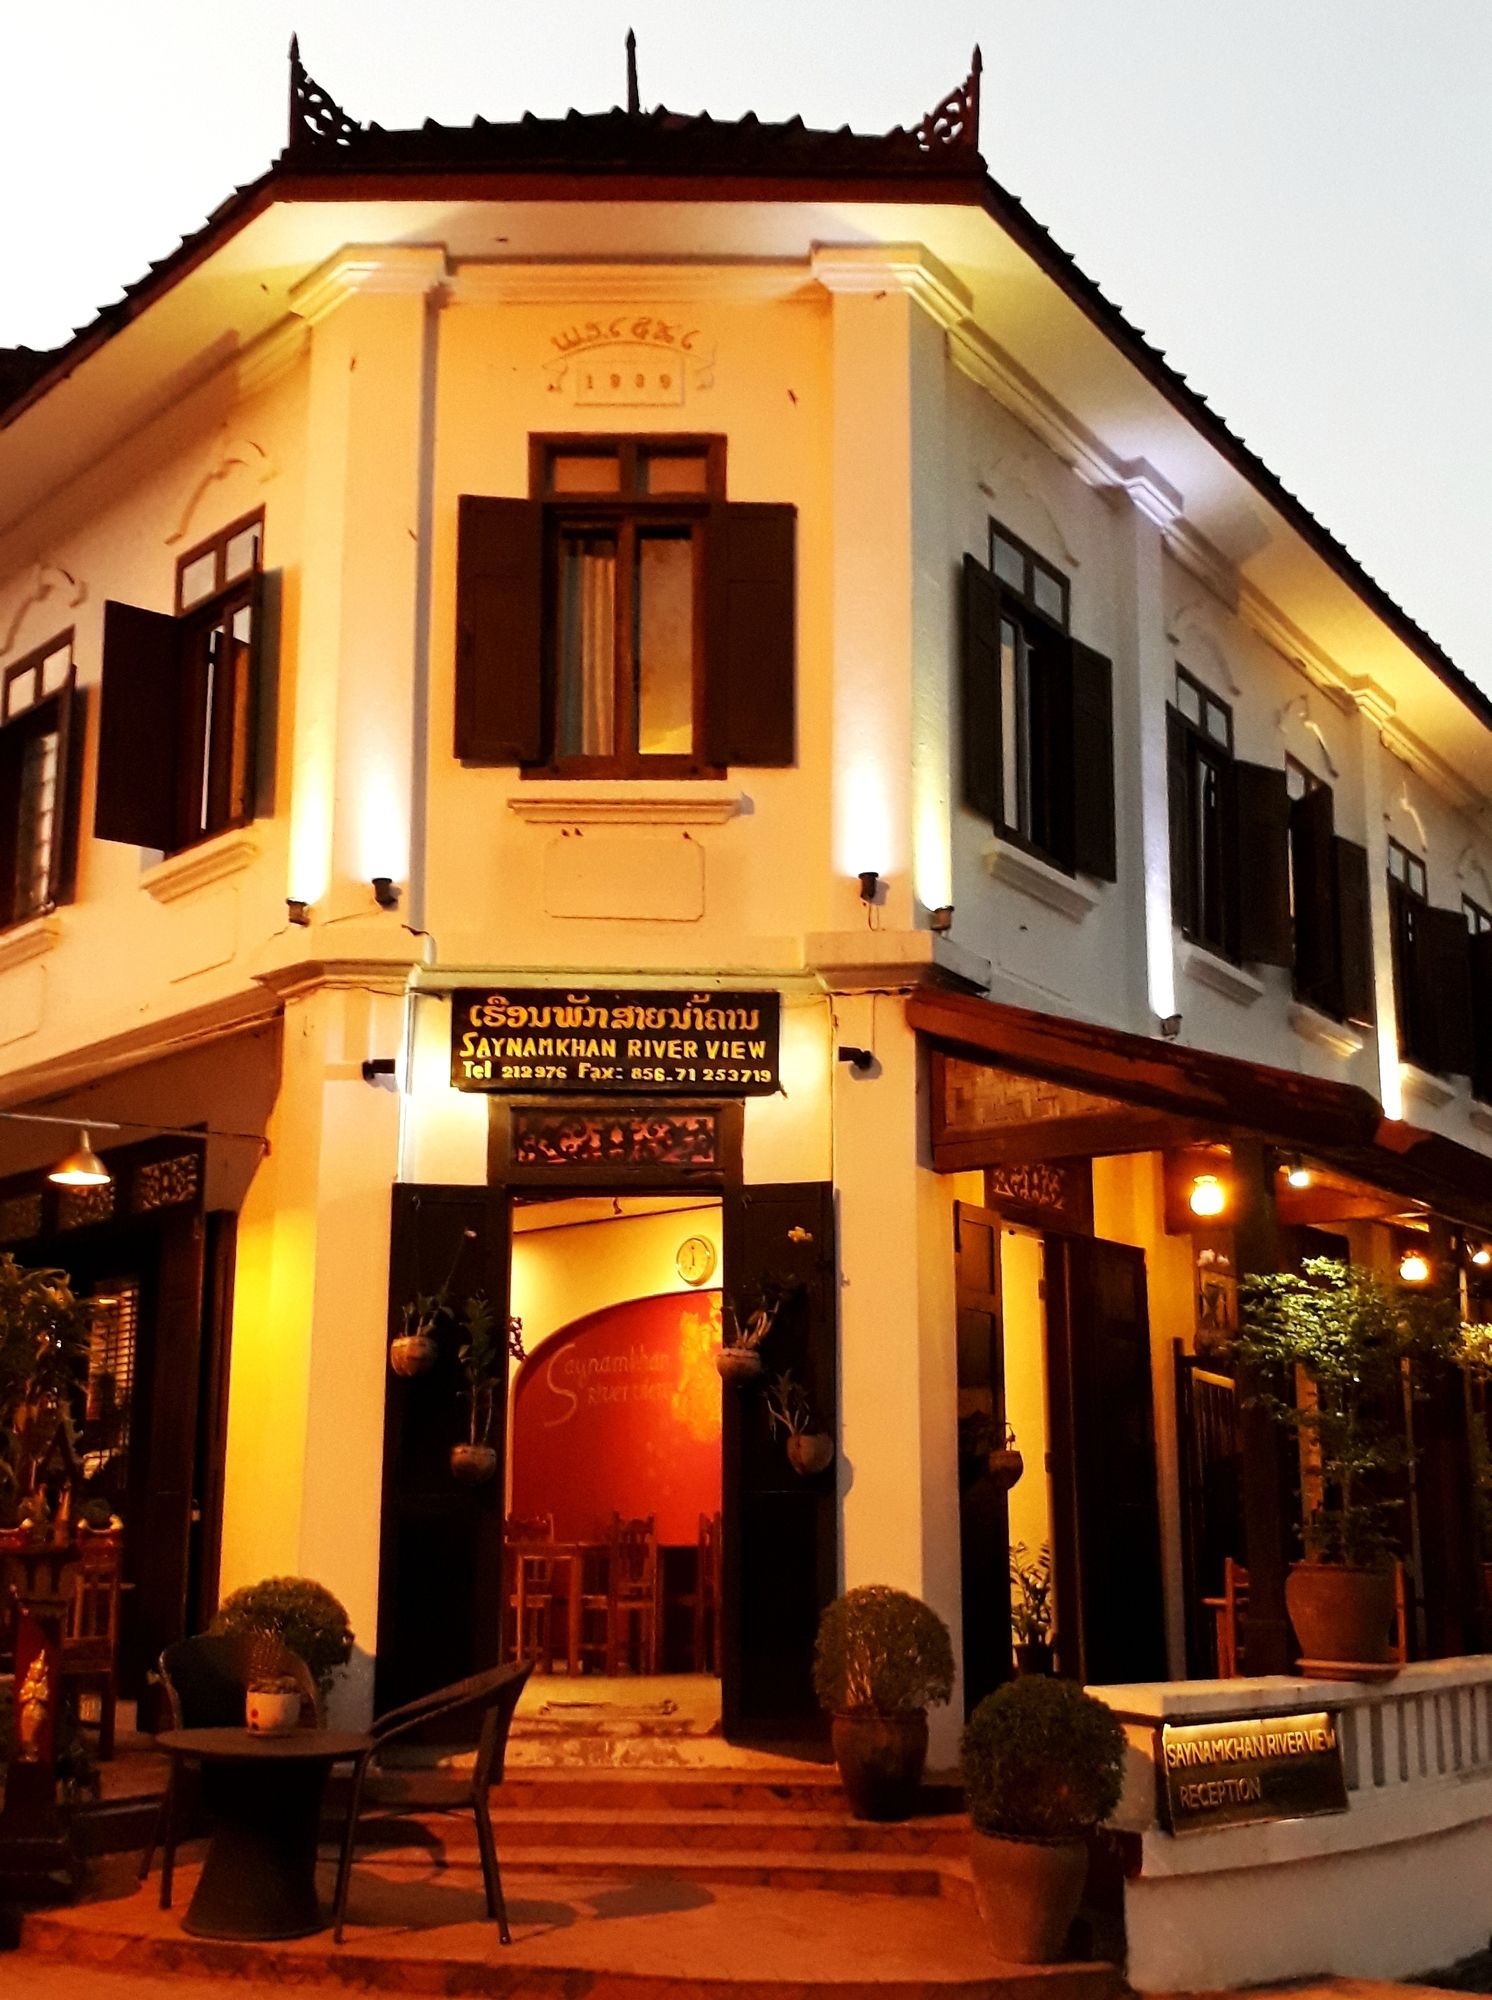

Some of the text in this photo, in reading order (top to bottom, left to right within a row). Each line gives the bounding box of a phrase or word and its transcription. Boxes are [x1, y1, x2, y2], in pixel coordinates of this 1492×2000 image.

[459, 1032, 767, 1060] SAYNAMKHAN RIVER VIEW
[462, 1061, 492, 1080] Tel
[578, 1062, 624, 1081] Fax:
[702, 1069, 772, 1083] 253719
[1167, 1728, 1336, 1769] SAYNAMKHAN RIVER VIEW
[1180, 1776, 1262, 1809] RECEPTION
